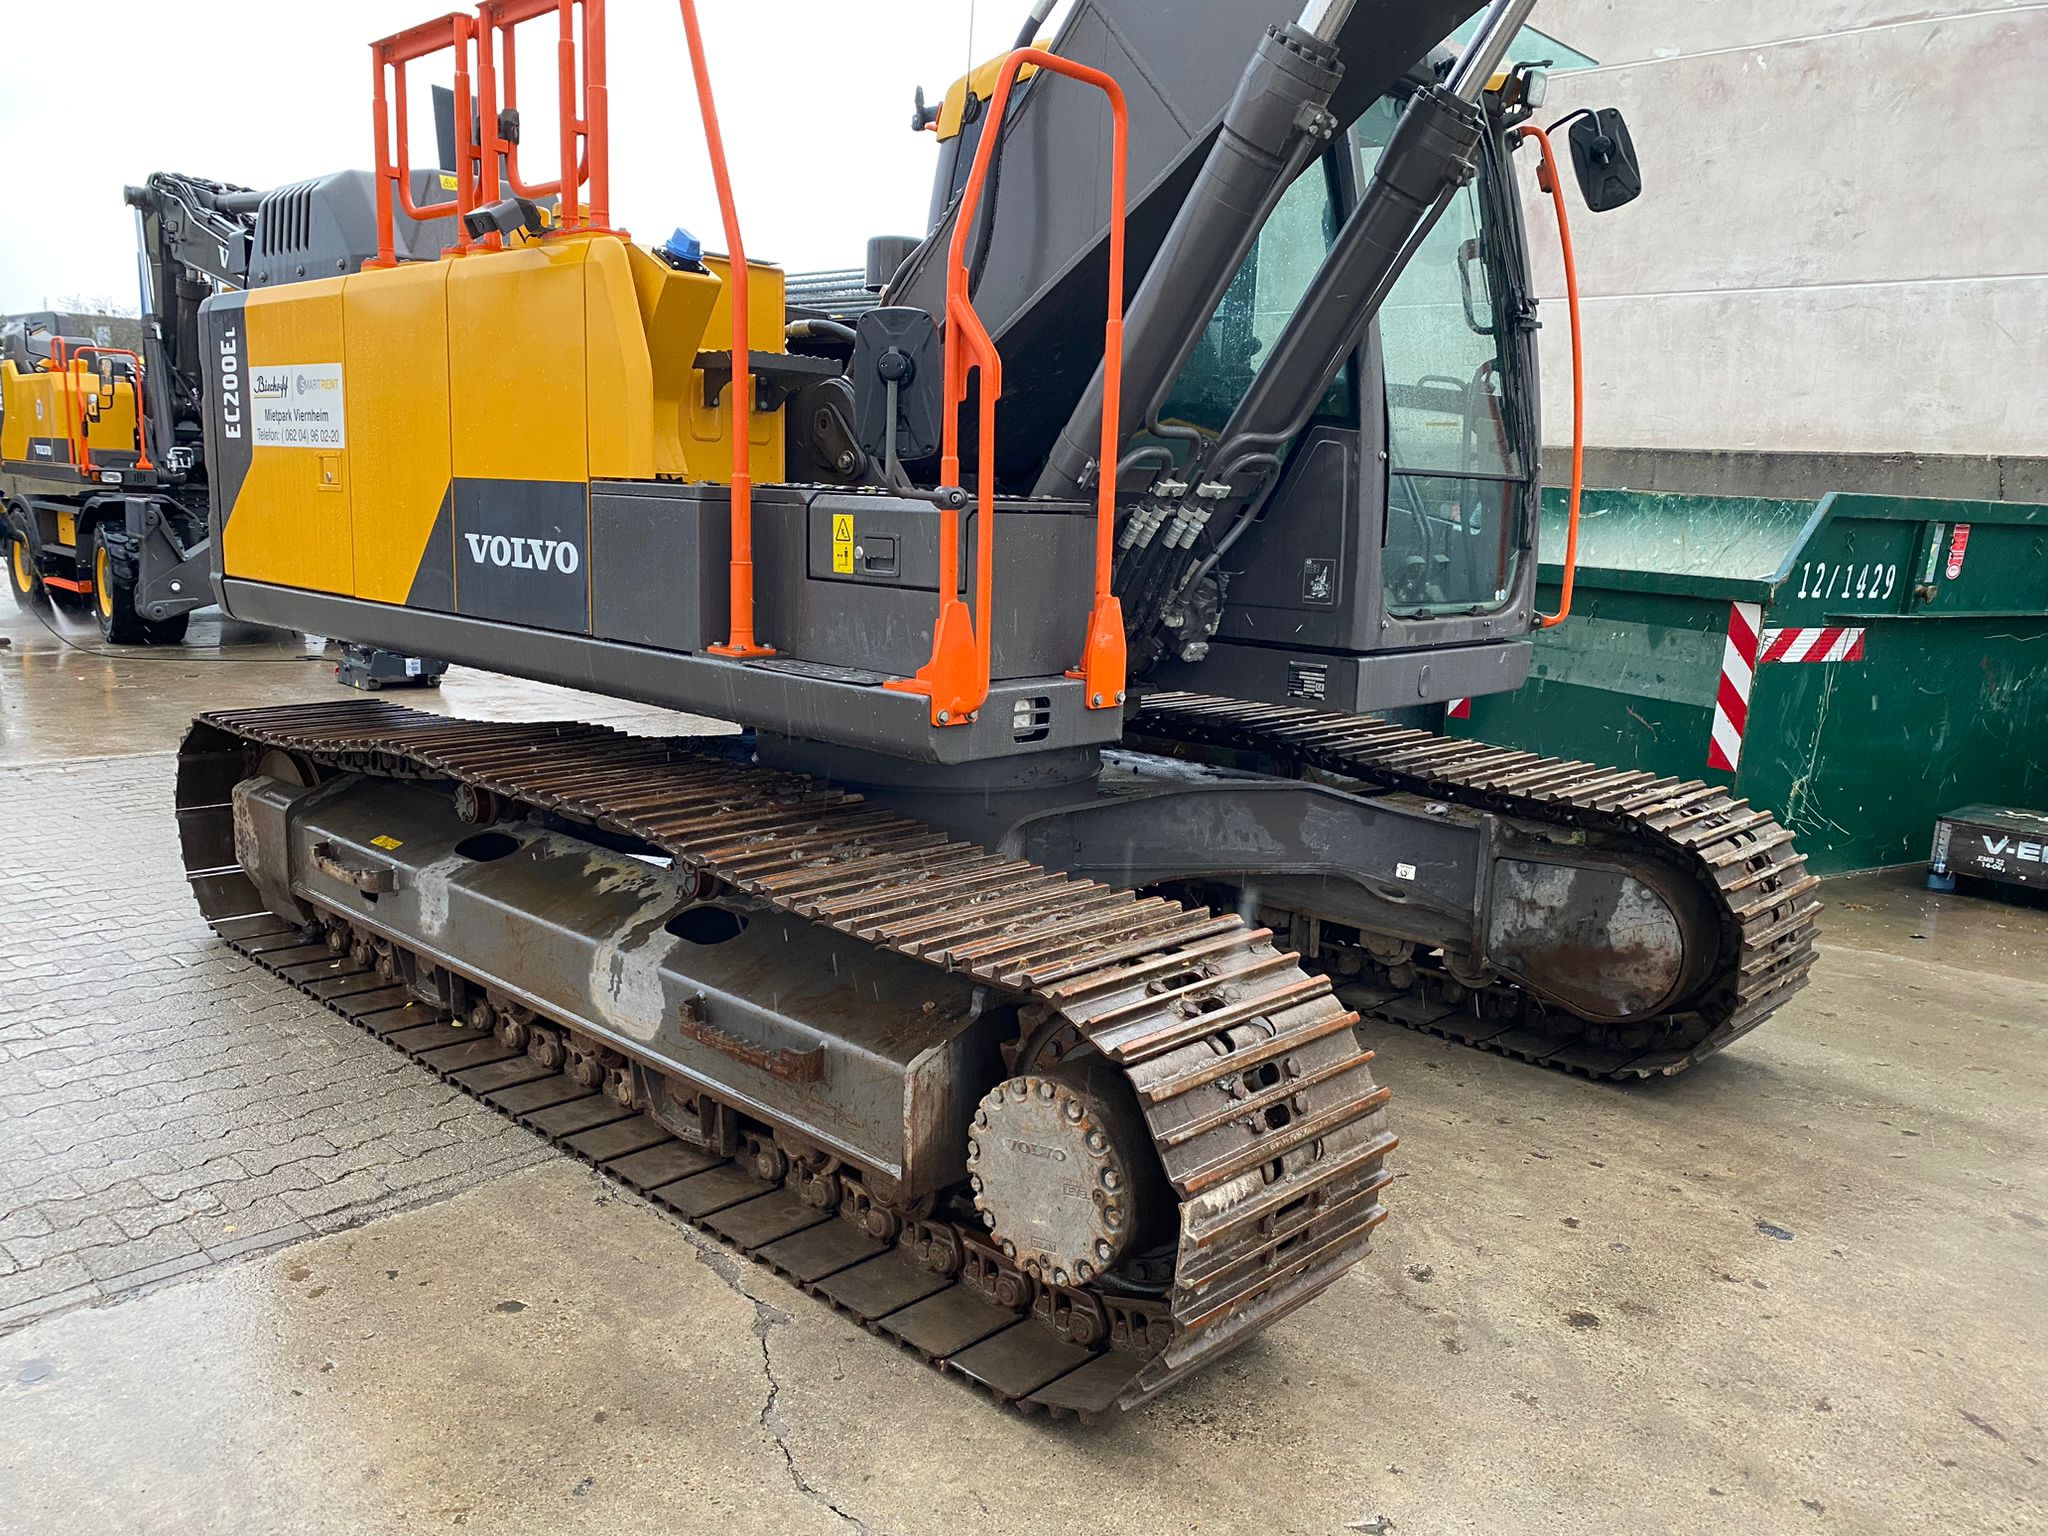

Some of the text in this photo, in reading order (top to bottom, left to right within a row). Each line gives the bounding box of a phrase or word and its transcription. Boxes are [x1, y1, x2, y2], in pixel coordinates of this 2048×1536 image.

[264, 408, 329, 424] Mietpark Viernheim
[464, 532, 579, 574] VOLVO
[1797, 561, 1897, 600] 12/1429
[1982, 834, 2048, 864] V-E
